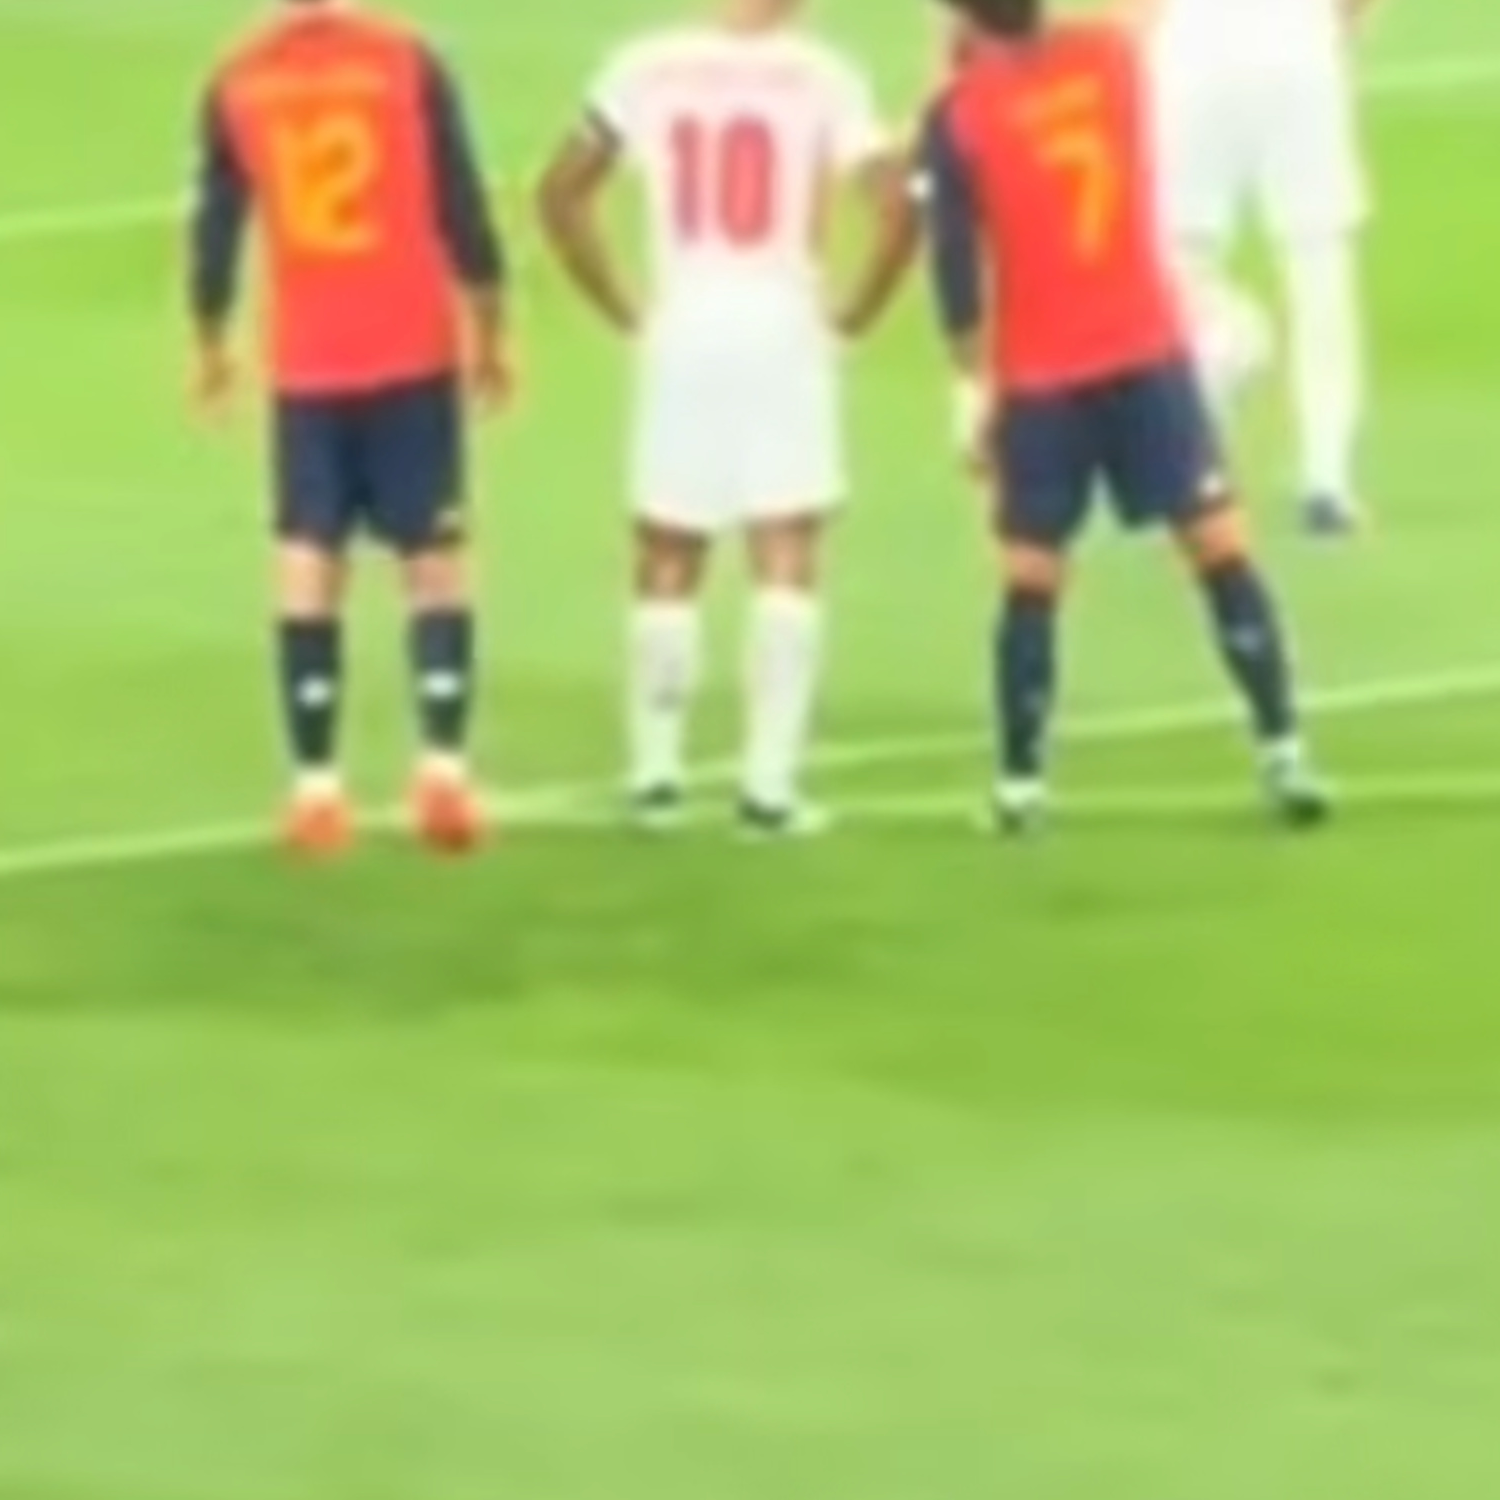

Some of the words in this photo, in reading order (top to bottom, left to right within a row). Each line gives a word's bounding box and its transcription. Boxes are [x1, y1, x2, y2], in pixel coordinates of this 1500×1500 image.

[268, 116, 380, 250] 12
[668, 115, 776, 248] 10
[1036, 130, 1122, 257] 7
